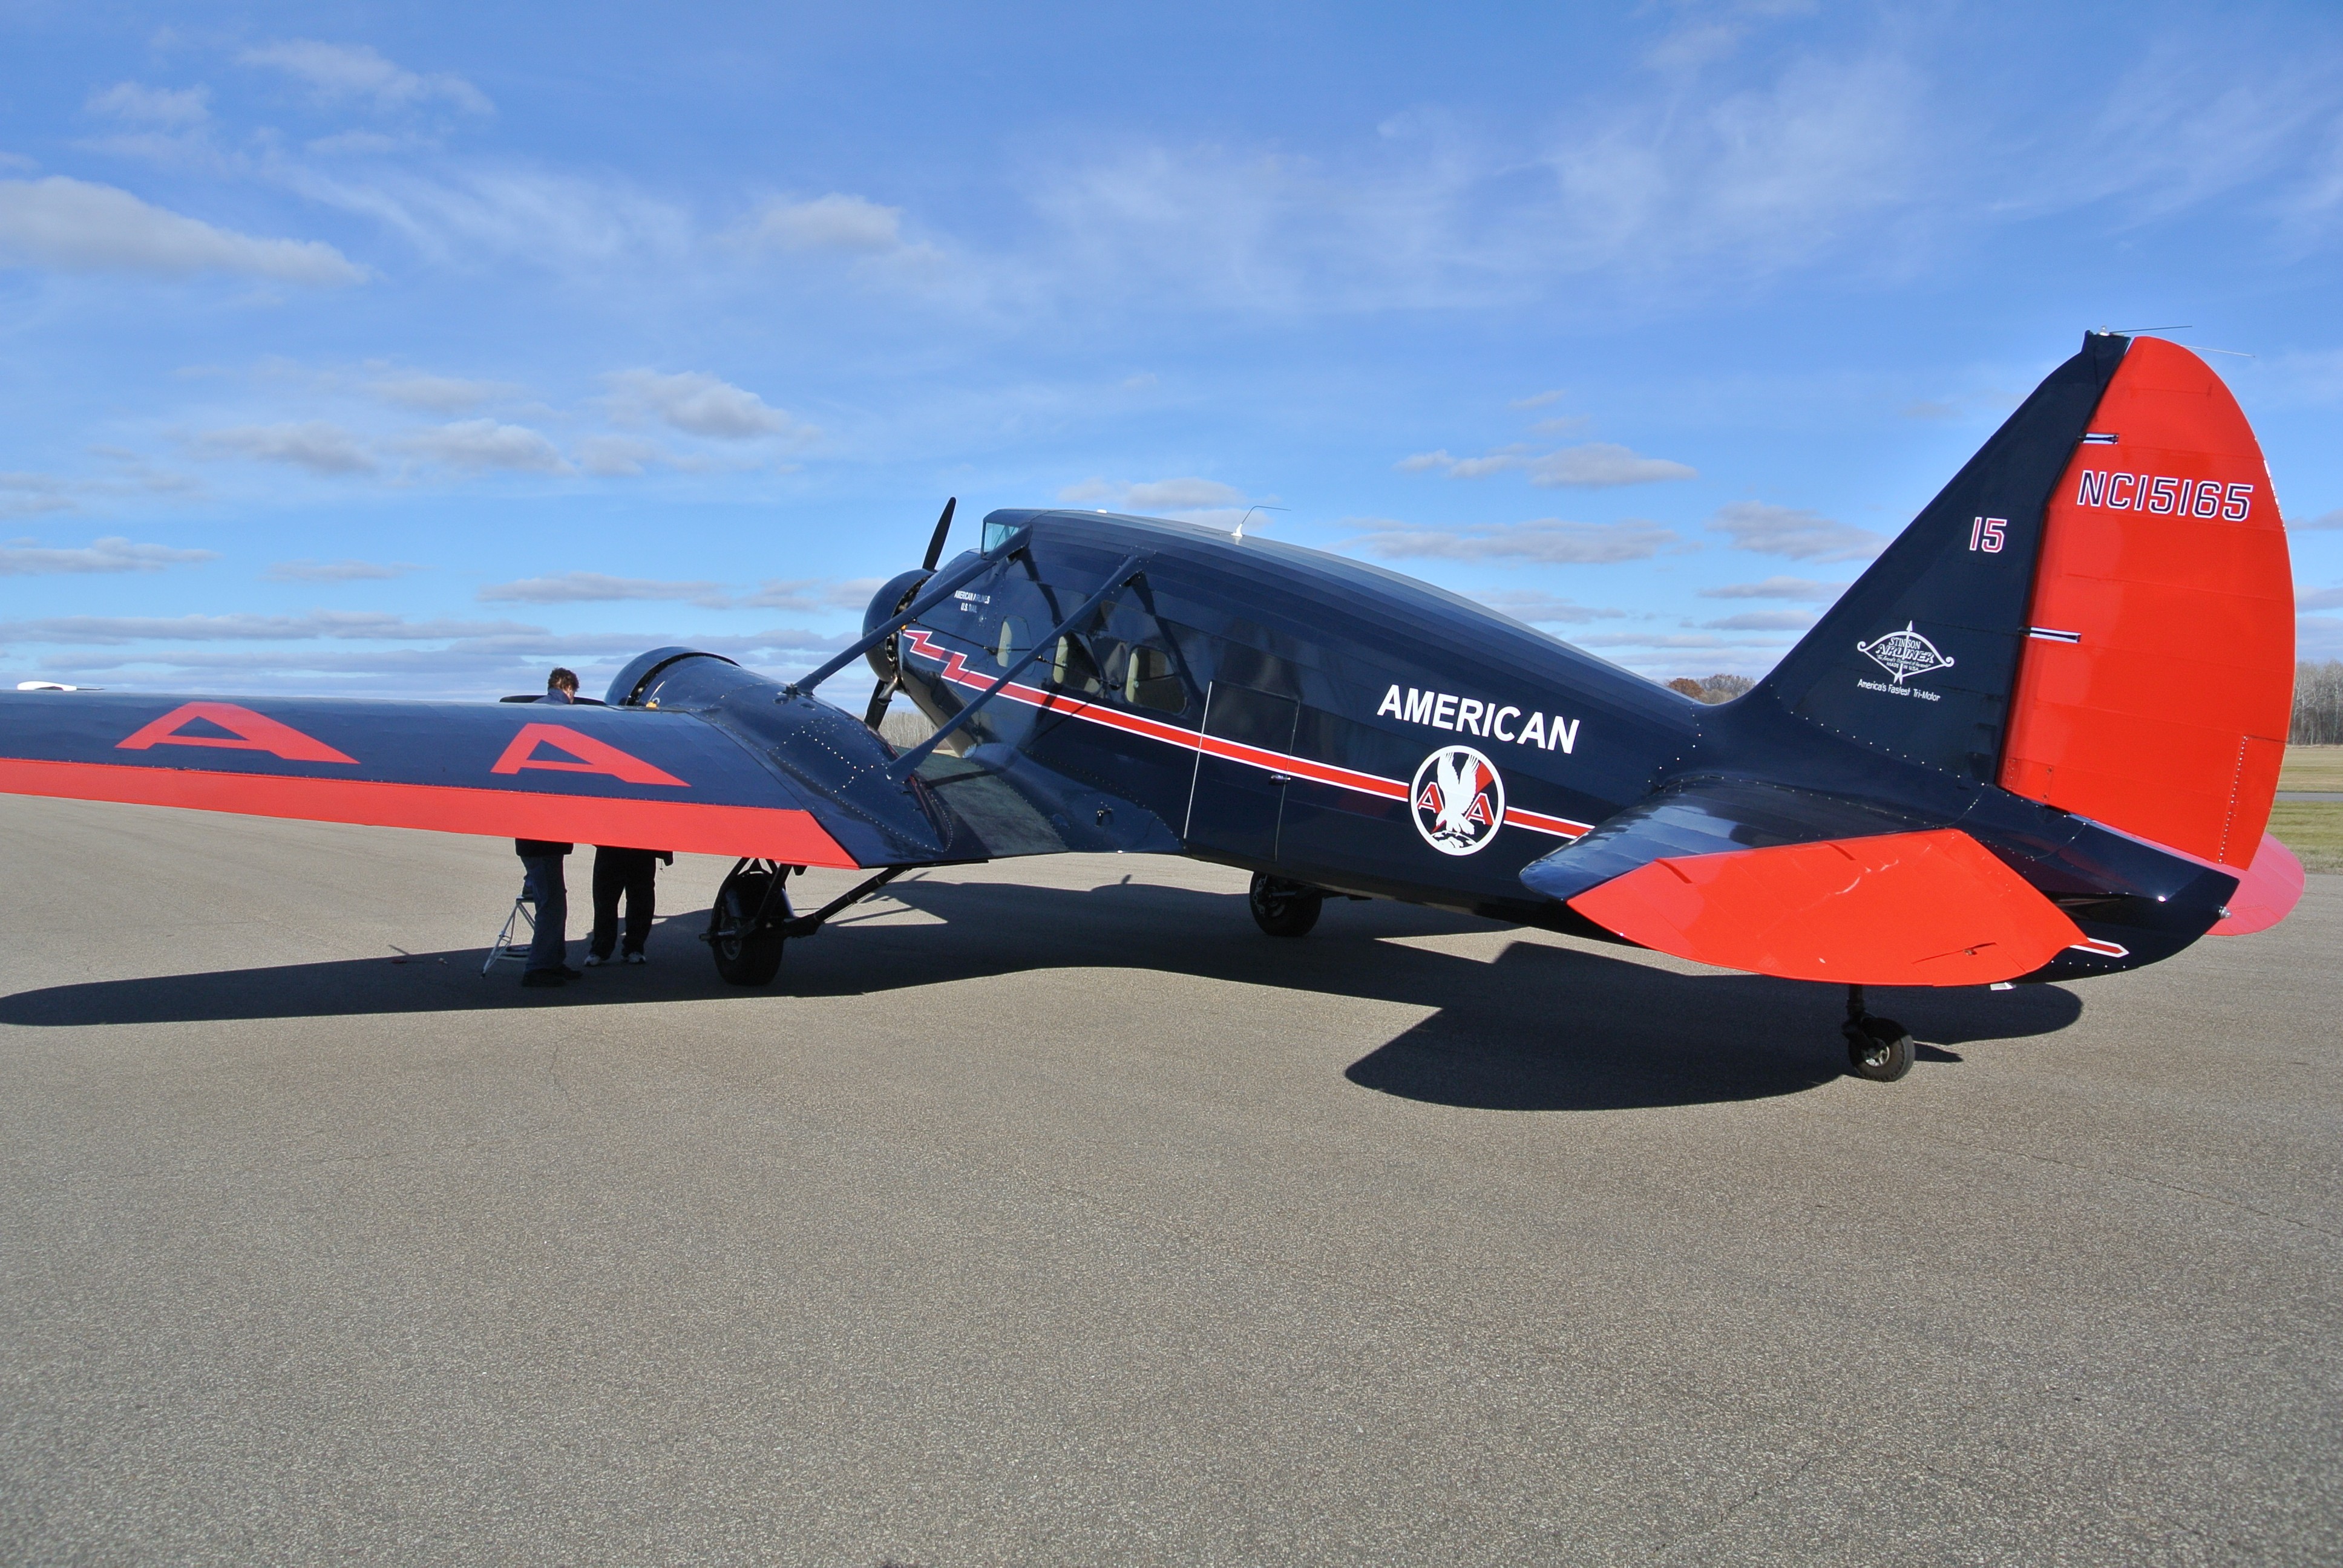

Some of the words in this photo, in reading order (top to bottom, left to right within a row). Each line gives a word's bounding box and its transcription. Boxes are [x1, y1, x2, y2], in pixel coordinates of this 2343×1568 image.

[2077, 469, 2253, 522] NC15165
[1969, 517, 2008, 554] 15
[1875, 644, 1935, 664] AIRLINER
[1889, 637, 1921, 650] STINSON
[1857, 679, 1887, 692] America's
[1888, 684, 1910, 696] Fastest
[1913, 688, 1941, 702] Tri-Motor
[1377, 684, 1581, 754] AMERICAN
